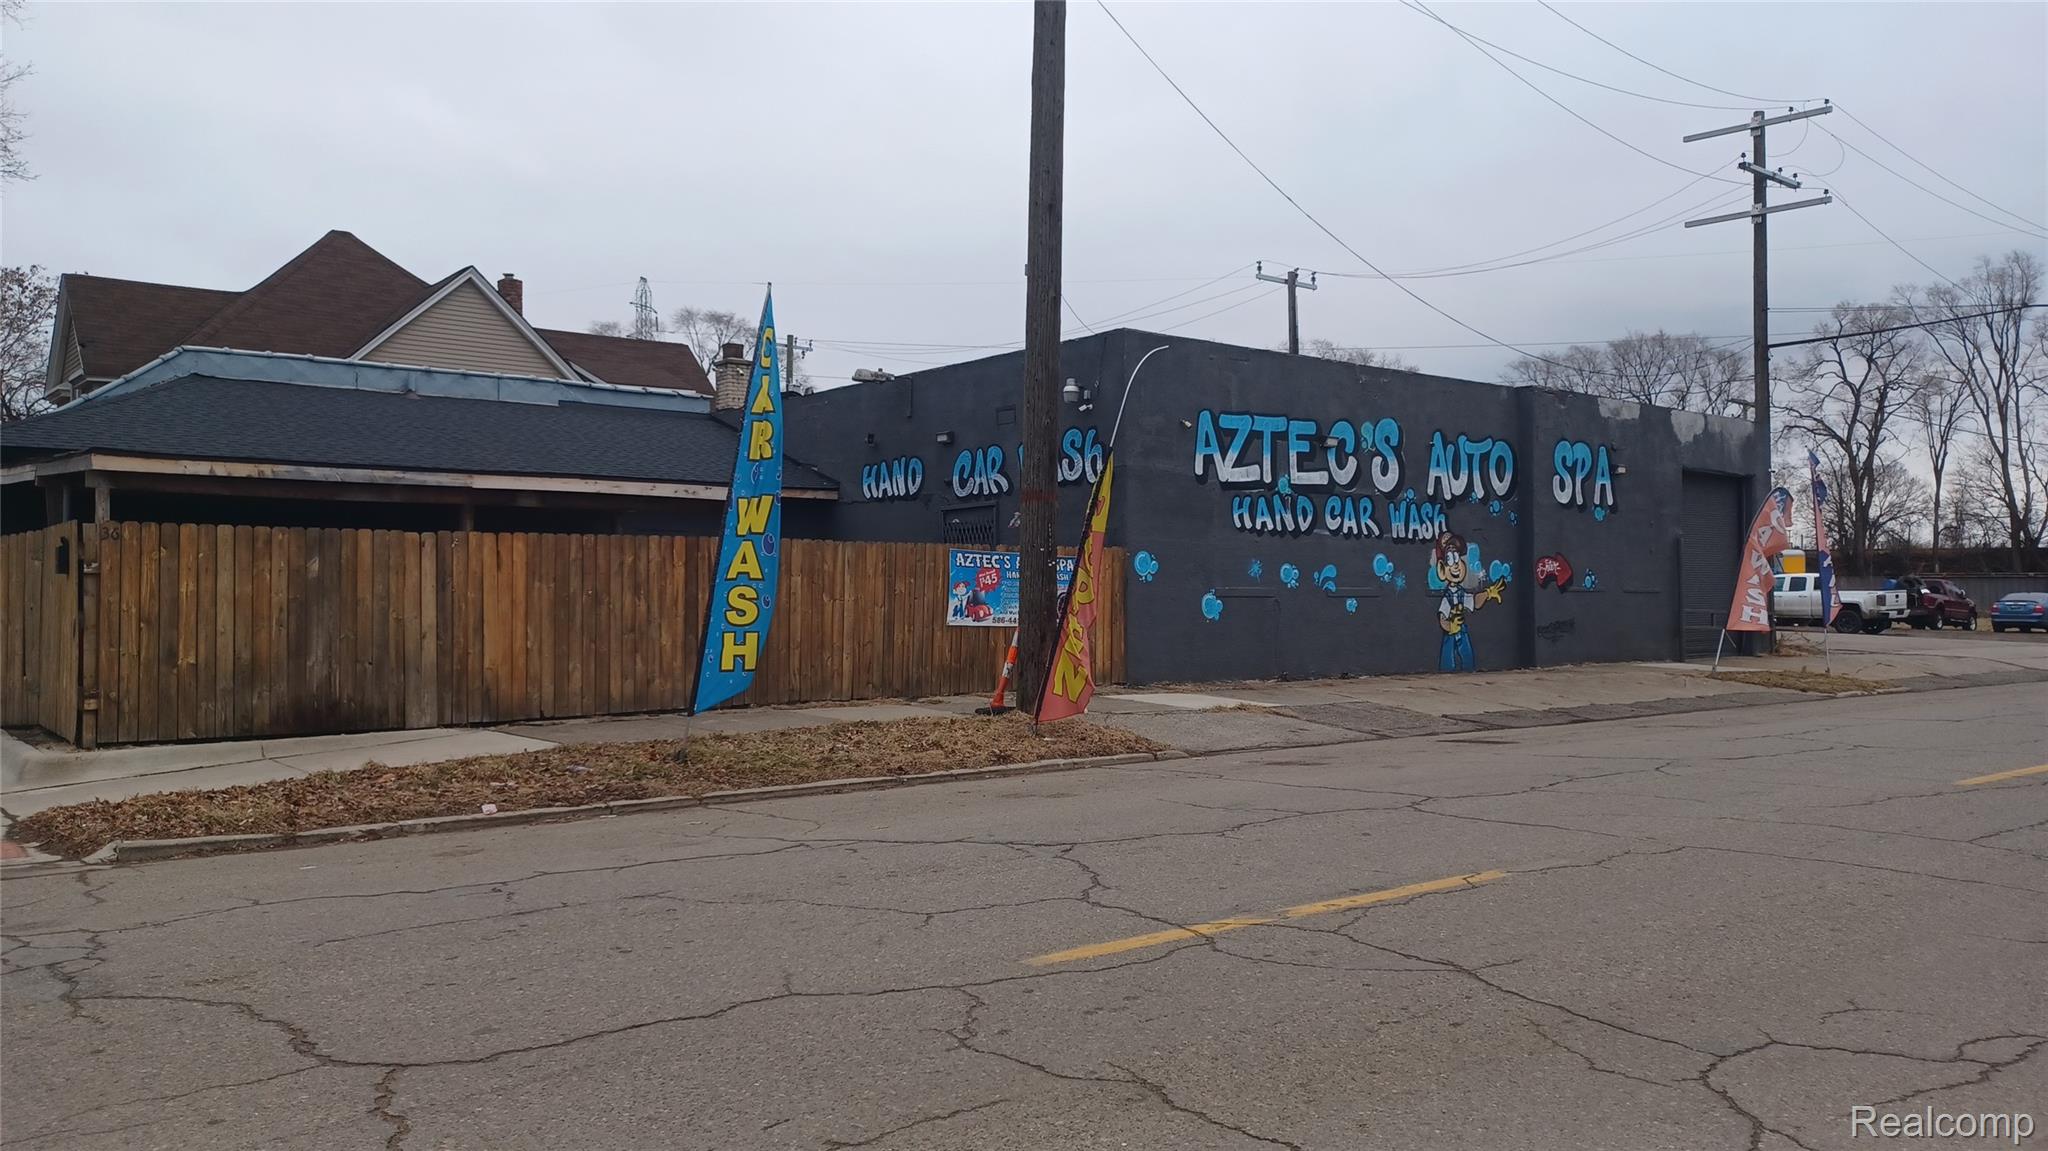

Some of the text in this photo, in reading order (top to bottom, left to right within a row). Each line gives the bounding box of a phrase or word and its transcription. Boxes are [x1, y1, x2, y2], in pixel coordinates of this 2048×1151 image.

[861, 456, 924, 500] HAND
[952, 445, 1010, 499] CAR
[1194, 408, 1615, 507] AZTEC'S AUTO SPA
[718, 327, 776, 673] CAR WASH
[1231, 494, 1315, 534] HAND
[1324, 494, 1382, 538] CAR
[955, 552, 1011, 569] AZTEC'S
